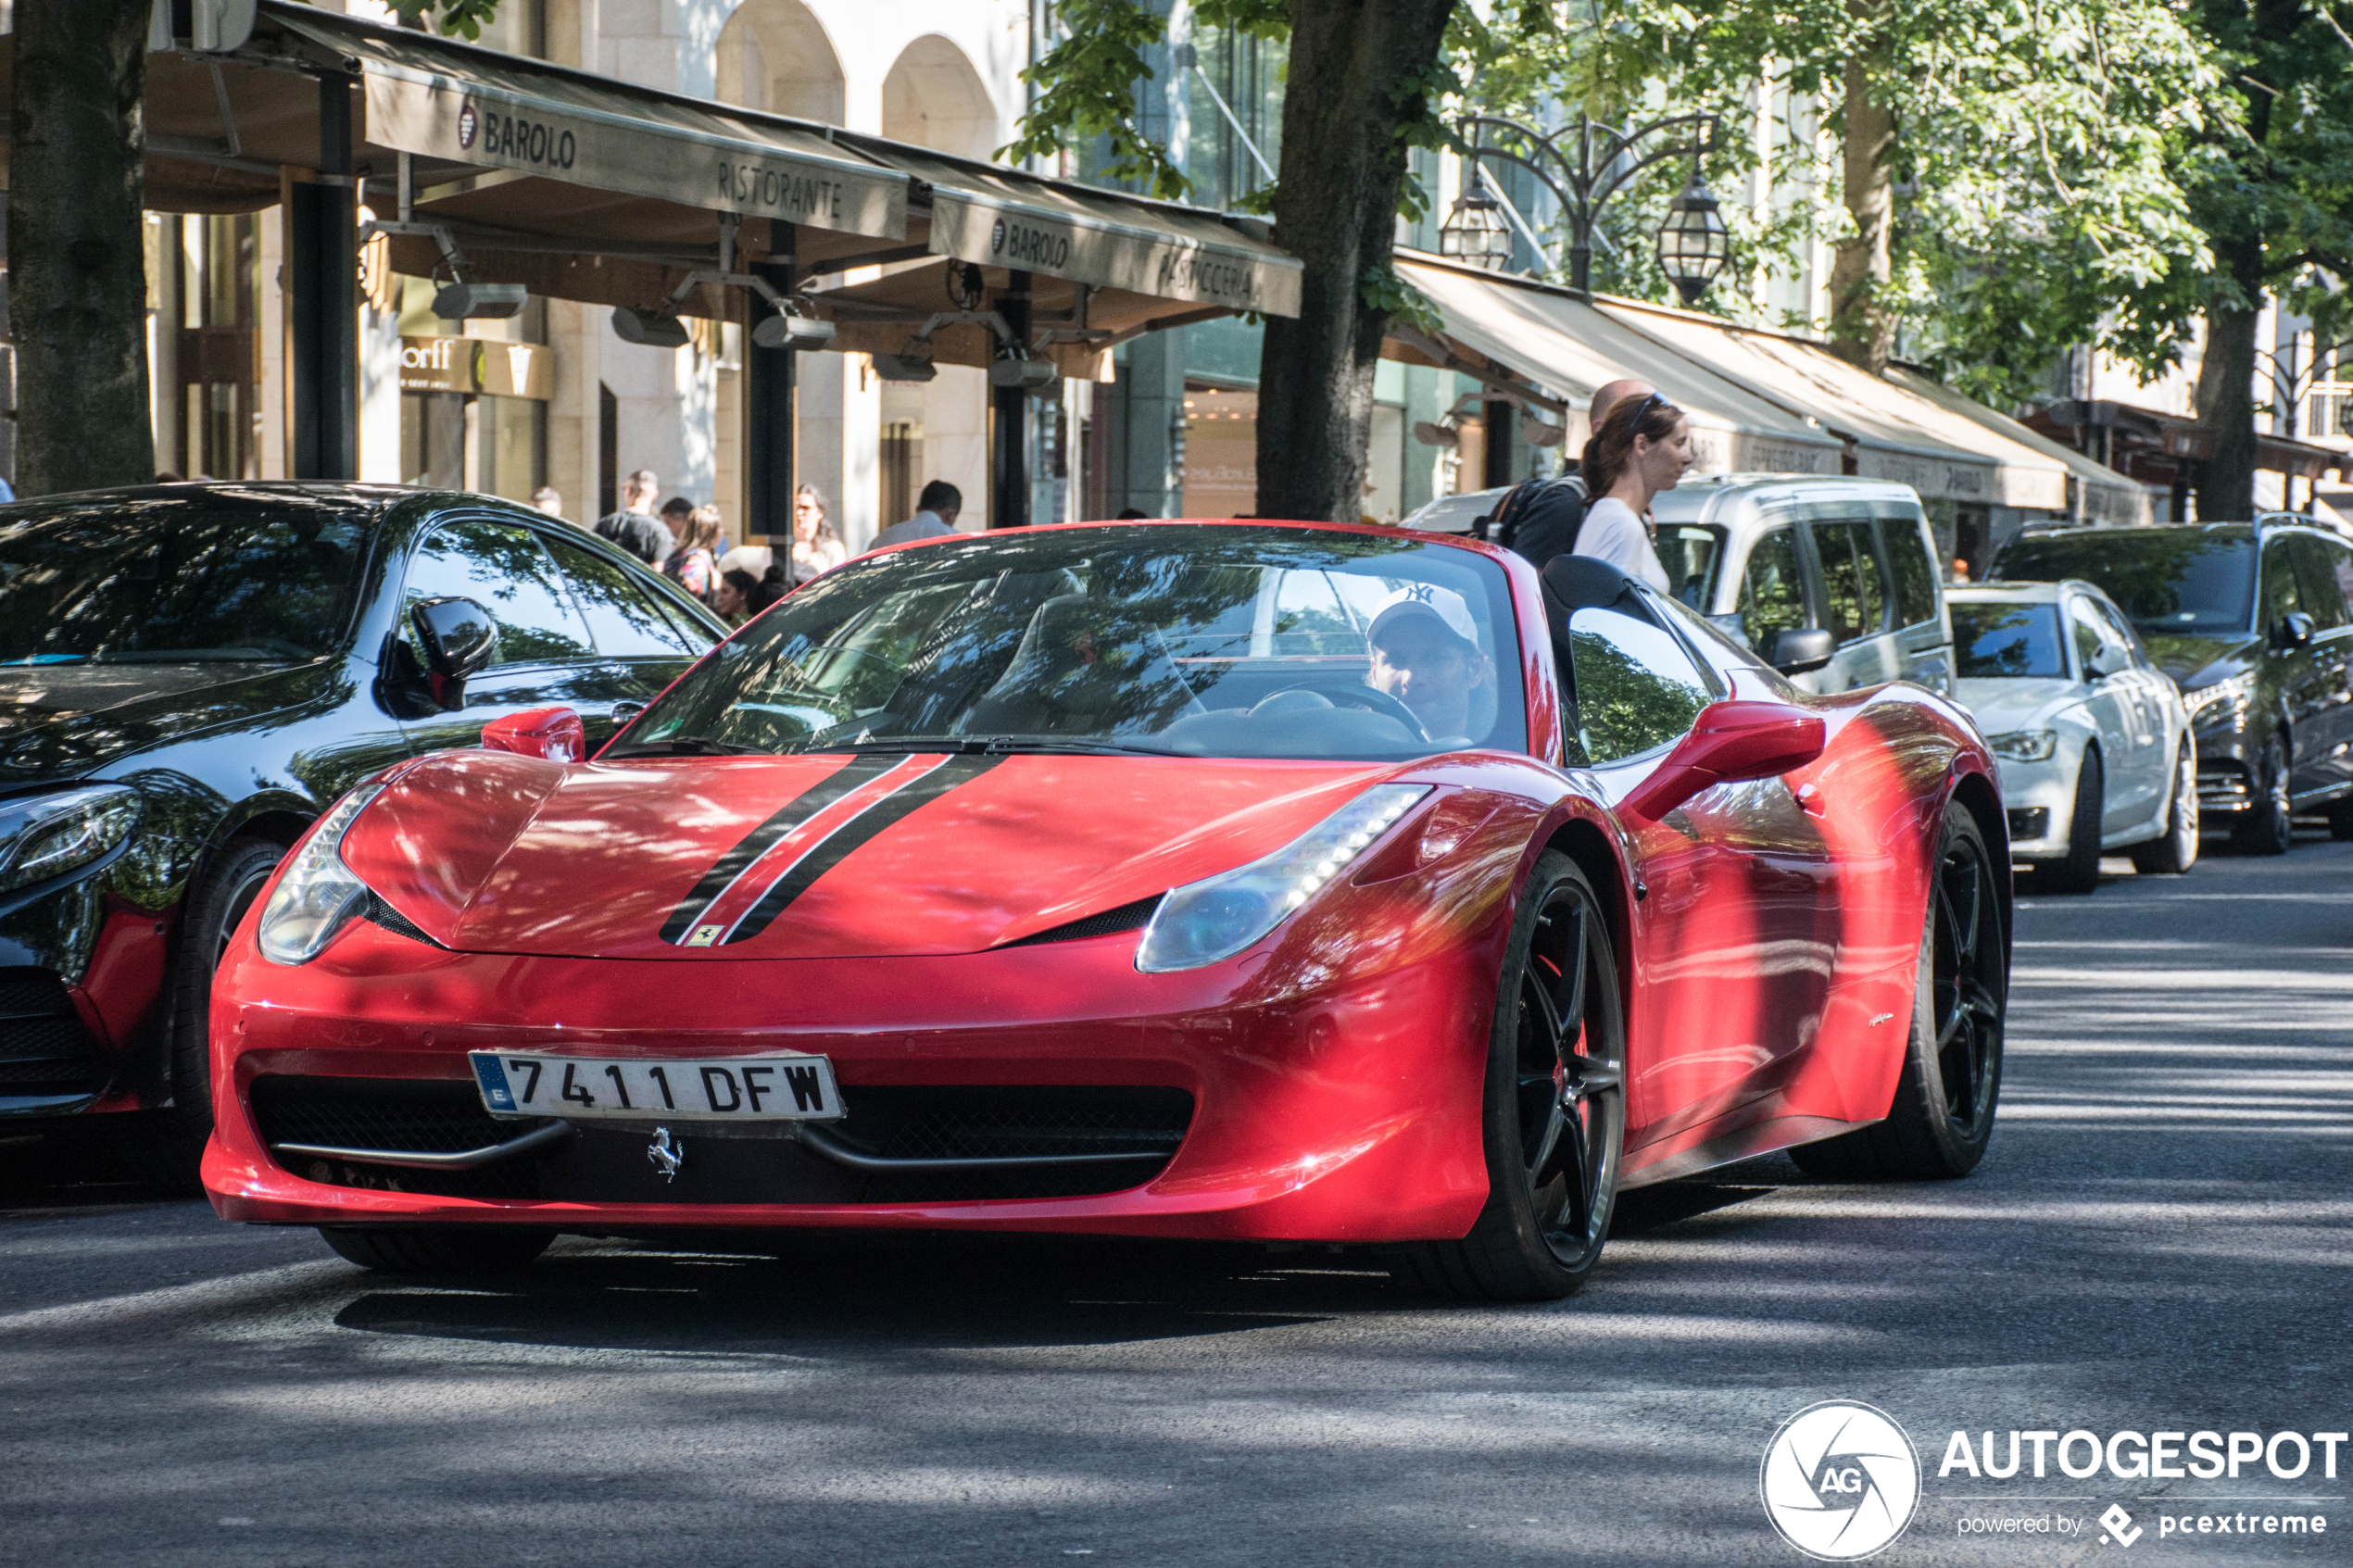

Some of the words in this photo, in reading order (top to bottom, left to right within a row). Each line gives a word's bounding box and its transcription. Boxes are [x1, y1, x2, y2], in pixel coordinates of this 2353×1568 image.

[484, 111, 575, 169] BAROLO
[718, 161, 842, 219] RISTORANTE
[1009, 223, 1069, 270] BAROLO
[1404, 583, 1434, 604] NY
[492, 1088, 507, 1102] E
[509, 1060, 674, 1110] 7411
[699, 1066, 824, 1112] DFW
